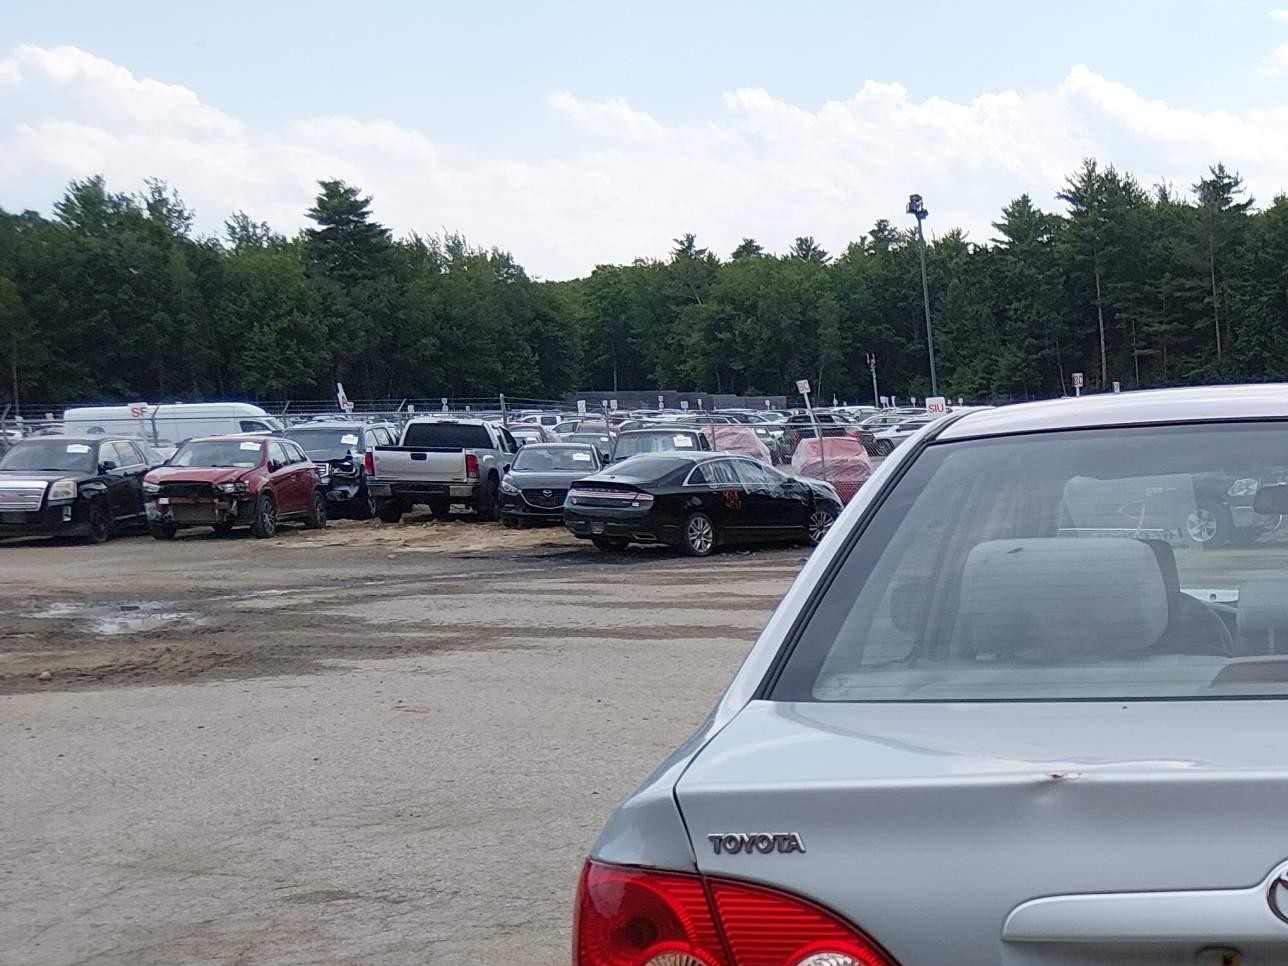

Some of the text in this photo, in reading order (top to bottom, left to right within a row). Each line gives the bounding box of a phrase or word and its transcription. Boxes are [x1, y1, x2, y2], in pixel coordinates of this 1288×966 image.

[131, 406, 147, 418] SF
[928, 403, 944, 414] SIU
[707, 832, 806, 855] TOYOTA
